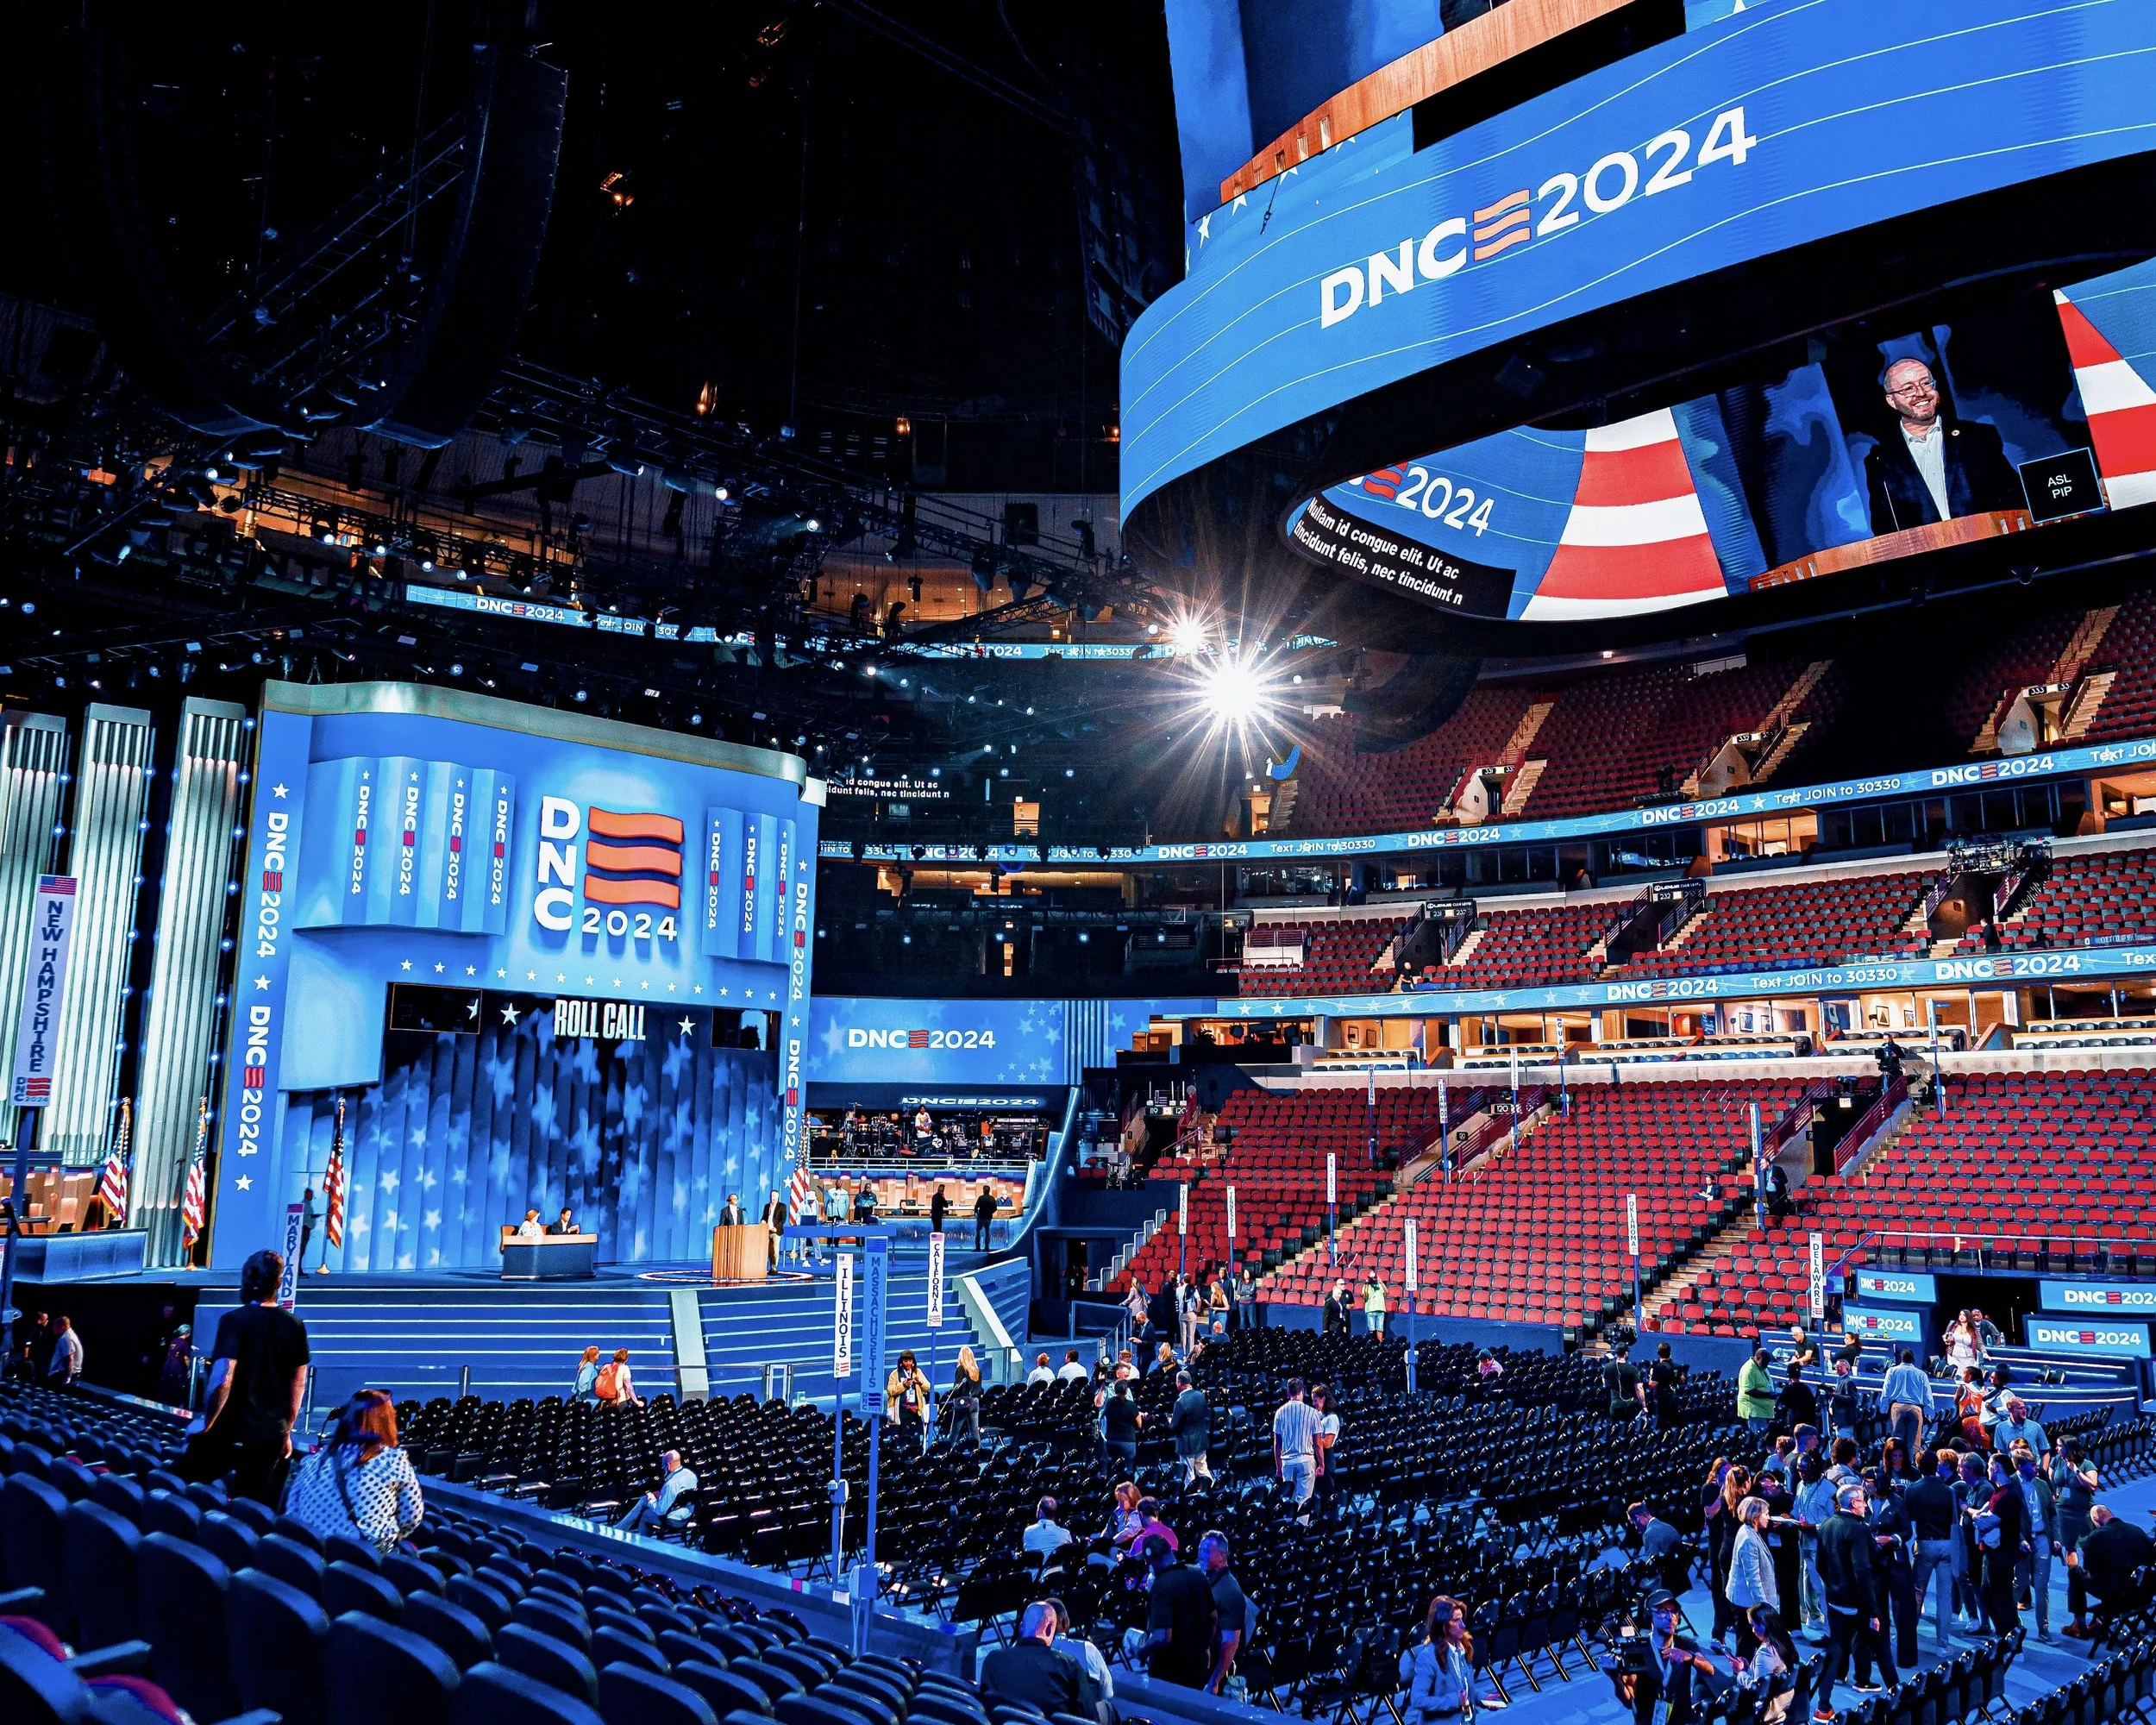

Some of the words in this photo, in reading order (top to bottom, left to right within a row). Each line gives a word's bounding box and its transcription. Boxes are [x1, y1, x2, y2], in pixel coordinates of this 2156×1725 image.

[1537, 106, 1757, 236] 2024
[1395, 466, 1495, 536] 2024
[2048, 474, 2071, 487] ASL
[2052, 486, 2072, 499] PIP
[1307, 497, 1336, 531] Nullam
[1336, 517, 1351, 536] id
[1350, 525, 1399, 556] congue
[1400, 543, 1424, 566] elit.
[1426, 555, 1443, 573] Ut
[1444, 564, 1460, 580] ac
[1294, 519, 1337, 562] tincidunt
[1337, 547, 1369, 574] felis,
[1371, 562, 1396, 582] nec
[1398, 571, 1451, 604] tincidunt
[1451, 593, 1463, 605] n
[524, 604, 565, 622] 2024
[1998, 756, 2055, 776] 2024
[2090, 748, 2123, 762] Text
[855, 787, 878, 797] felis,
[899, 789, 941, 798] tincidunt
[857, 780, 891, 788] congue
[893, 780, 912, 788] elit.
[1774, 791, 1802, 806] Text
[1804, 787, 1837, 801] JOIN
[1839, 785, 1854, 796] to
[1857, 778, 1901, 794] 30330
[1695, 799, 1740, 817] 2024
[1082, 850, 1094, 858] to
[1207, 844, 1248, 857] 2024
[1270, 843, 1294, 853] Text
[1296, 842, 1324, 853] JOIN
[1339, 839, 1376, 850] 30330
[1458, 827, 1501, 843] 2024
[351, 845, 365, 894] 2024
[399, 847, 414, 895] 2024
[447, 852, 460, 900] 2024
[491, 857, 504, 906] 2024
[41, 900, 64, 941] NEW
[256, 894, 280, 958] 2024
[581, 907, 678, 941] 2024
[707, 886, 718, 929] 2024
[744, 890, 754, 933] 2024
[777, 894, 786, 937] 2024
[792, 948, 805, 1000] 2024
[1751, 975, 1783, 988] Text
[1785, 973, 1823, 987] JOIN
[1826, 972, 1841, 984] to
[1846, 968, 1898, 983] 30330
[2014, 954, 2081, 975] 2024
[2122, 952, 2156, 966] Tex
[1667, 978, 1719, 997] 2024
[28, 948, 57, 1072] HAMPSHIRE
[554, 999, 599, 1038] ROLL
[603, 1003, 646, 1041] CALL
[930, 1030, 996, 1050] 2024
[237, 1089, 262, 1157] 2024
[784, 1107, 798, 1161] 2024
[281, 1214, 300, 1298] MARYLAND
[1813, 1243, 1821, 1306] DELAWARE
[931, 1243, 941, 1313] CALIFORNIA
[838, 1268, 849, 1358] ILLINOIS
[868, 1256, 881, 1389] MASSACHUSETTS
[2095, 1332, 2141, 1346] 2024
